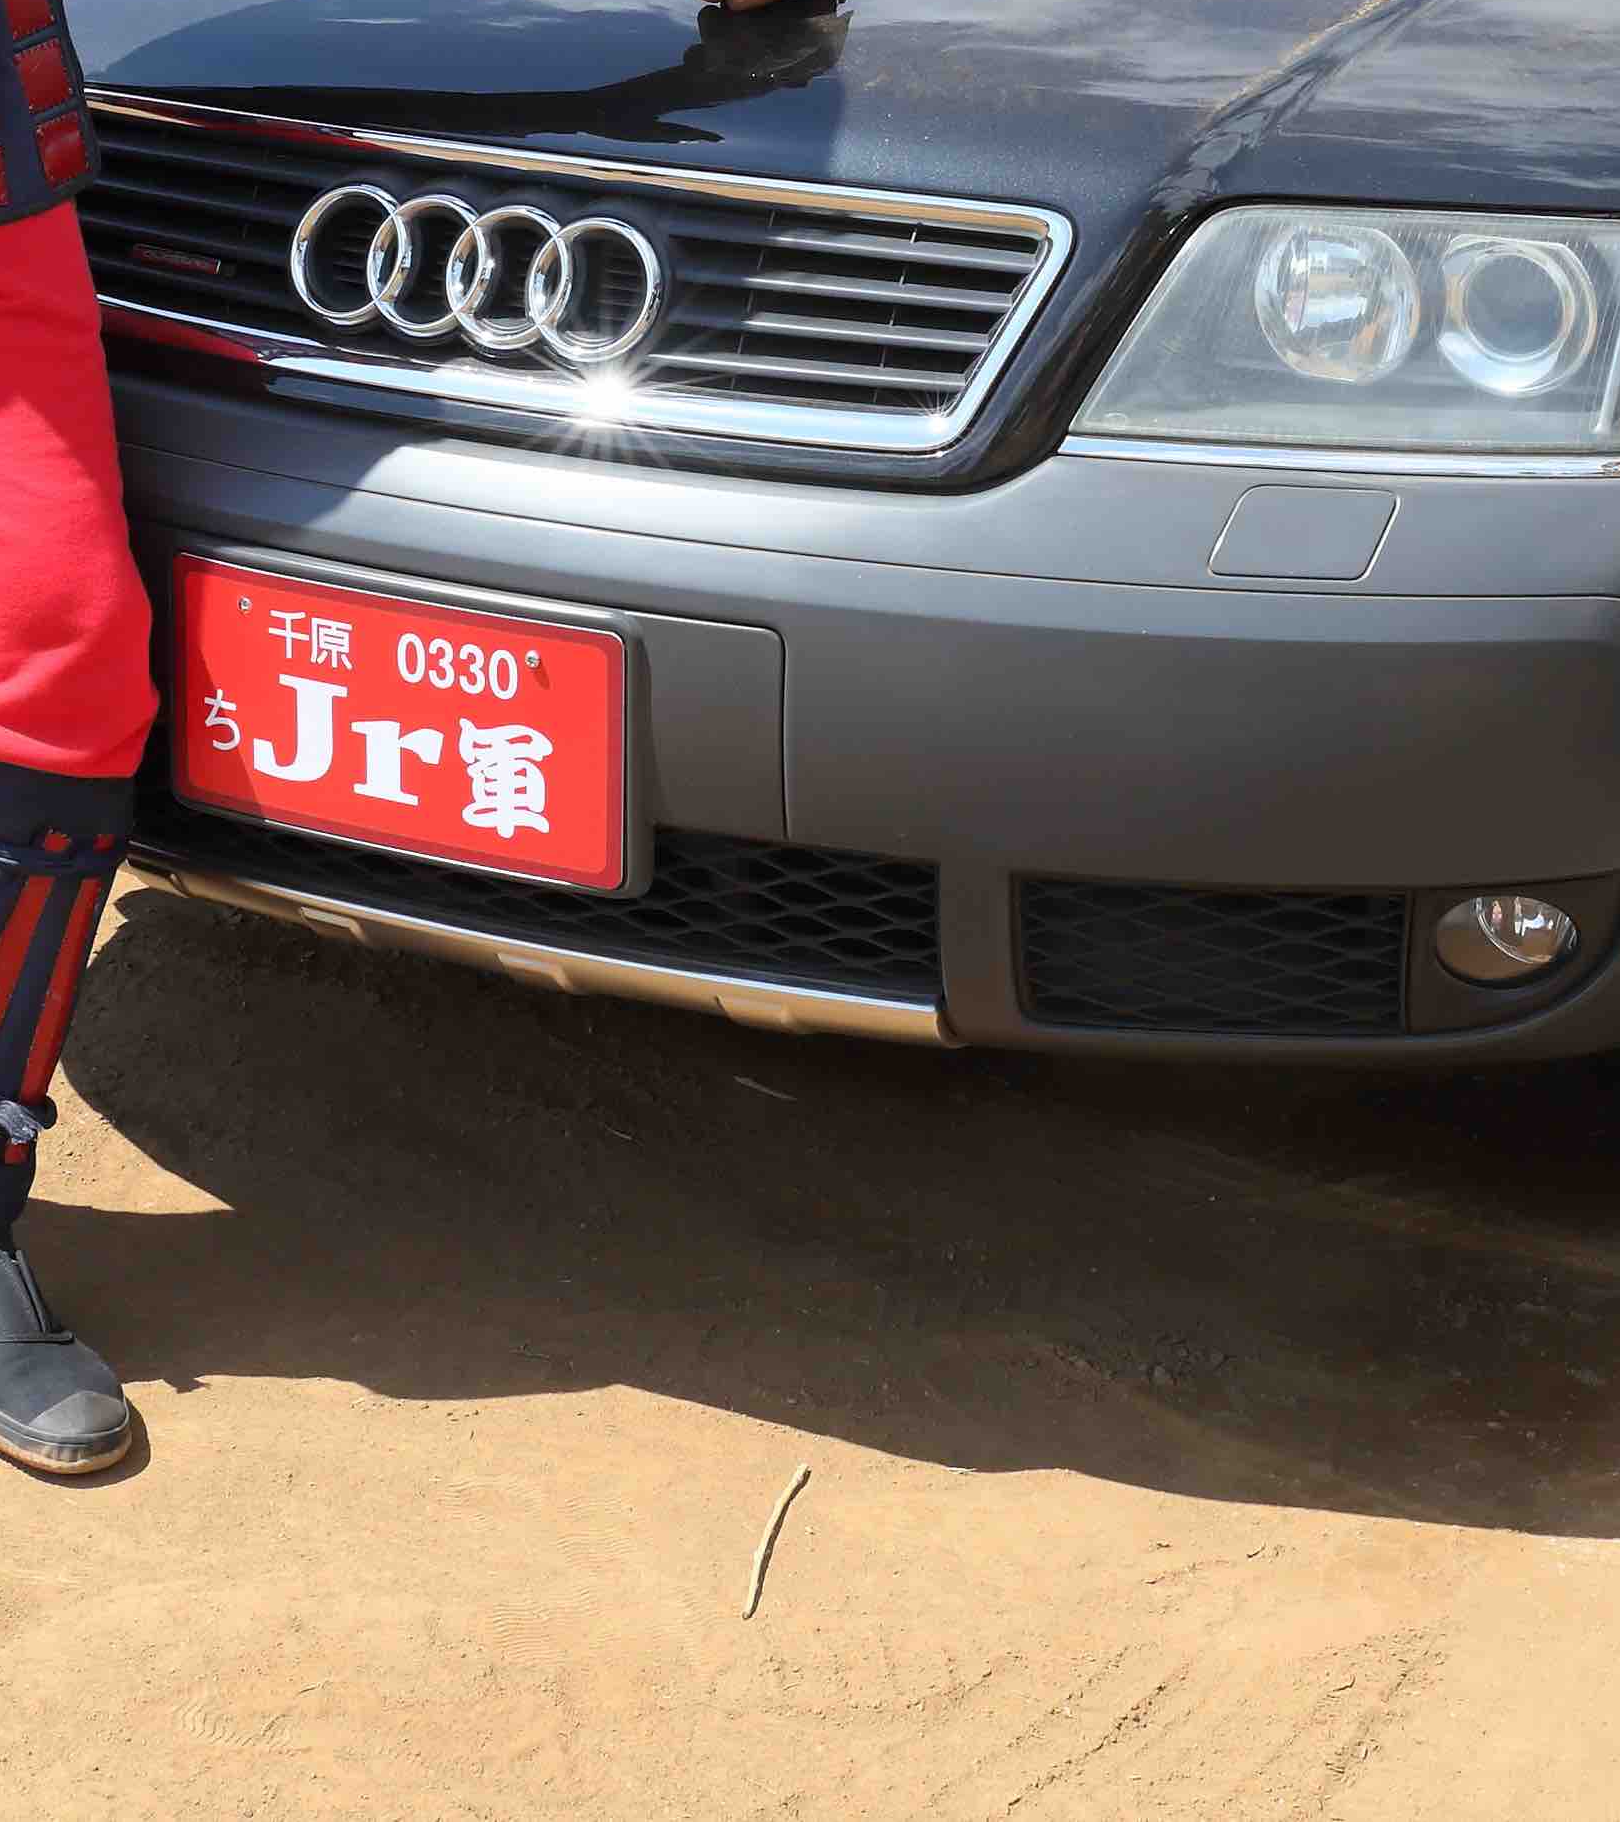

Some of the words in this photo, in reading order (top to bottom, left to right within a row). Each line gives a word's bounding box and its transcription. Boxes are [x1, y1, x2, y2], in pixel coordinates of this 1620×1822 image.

[268, 609, 354, 671] 千原
[396, 632, 519, 700] 0330
[203, 688, 241, 752] ち
